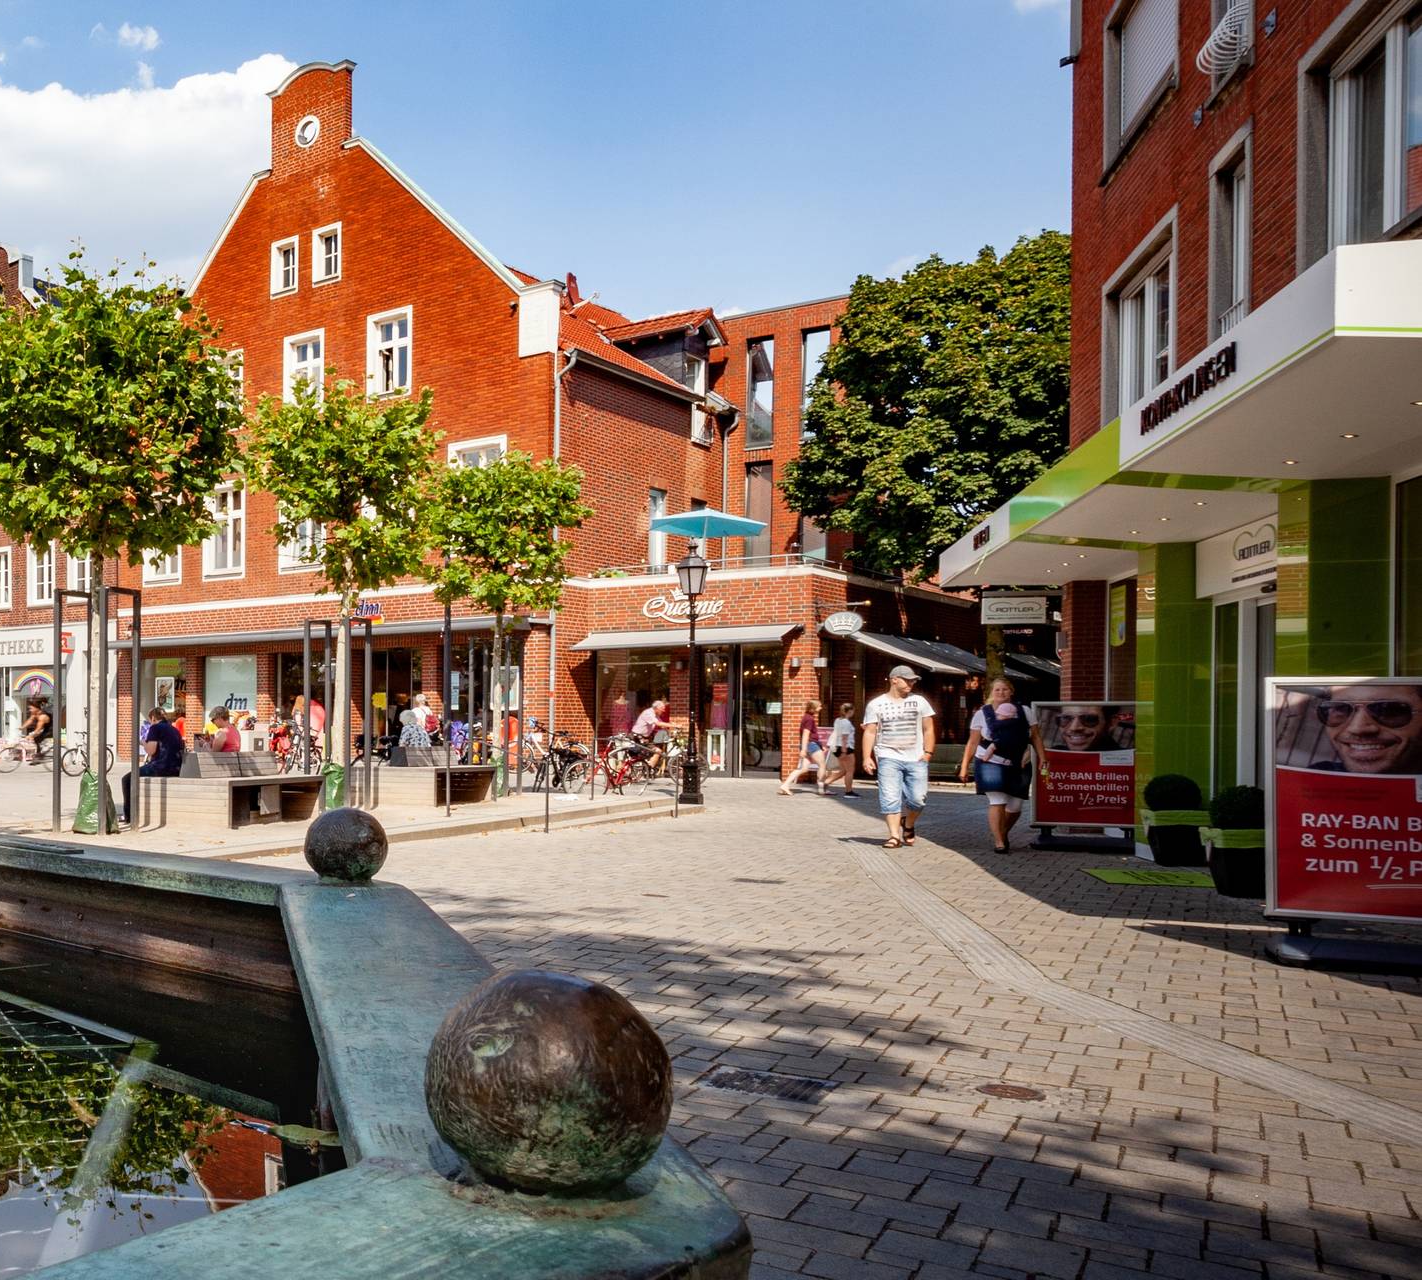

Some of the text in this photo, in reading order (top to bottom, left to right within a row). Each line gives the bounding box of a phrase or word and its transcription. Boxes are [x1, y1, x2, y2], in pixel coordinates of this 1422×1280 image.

[354, 599, 381, 616] dm
[224, 693, 248, 711] dm
[1049, 772, 1130, 782] RAY-BAN Brillen
[1046, 782, 1130, 792] & Sonnenbrillen
[1048, 795, 1074, 803] zum
[1096, 795, 1128, 804] Preis
[1300, 812, 1399, 831] RAY-BAN
[1300, 833, 1317, 848] &
[1305, 858, 1359, 873] zum
